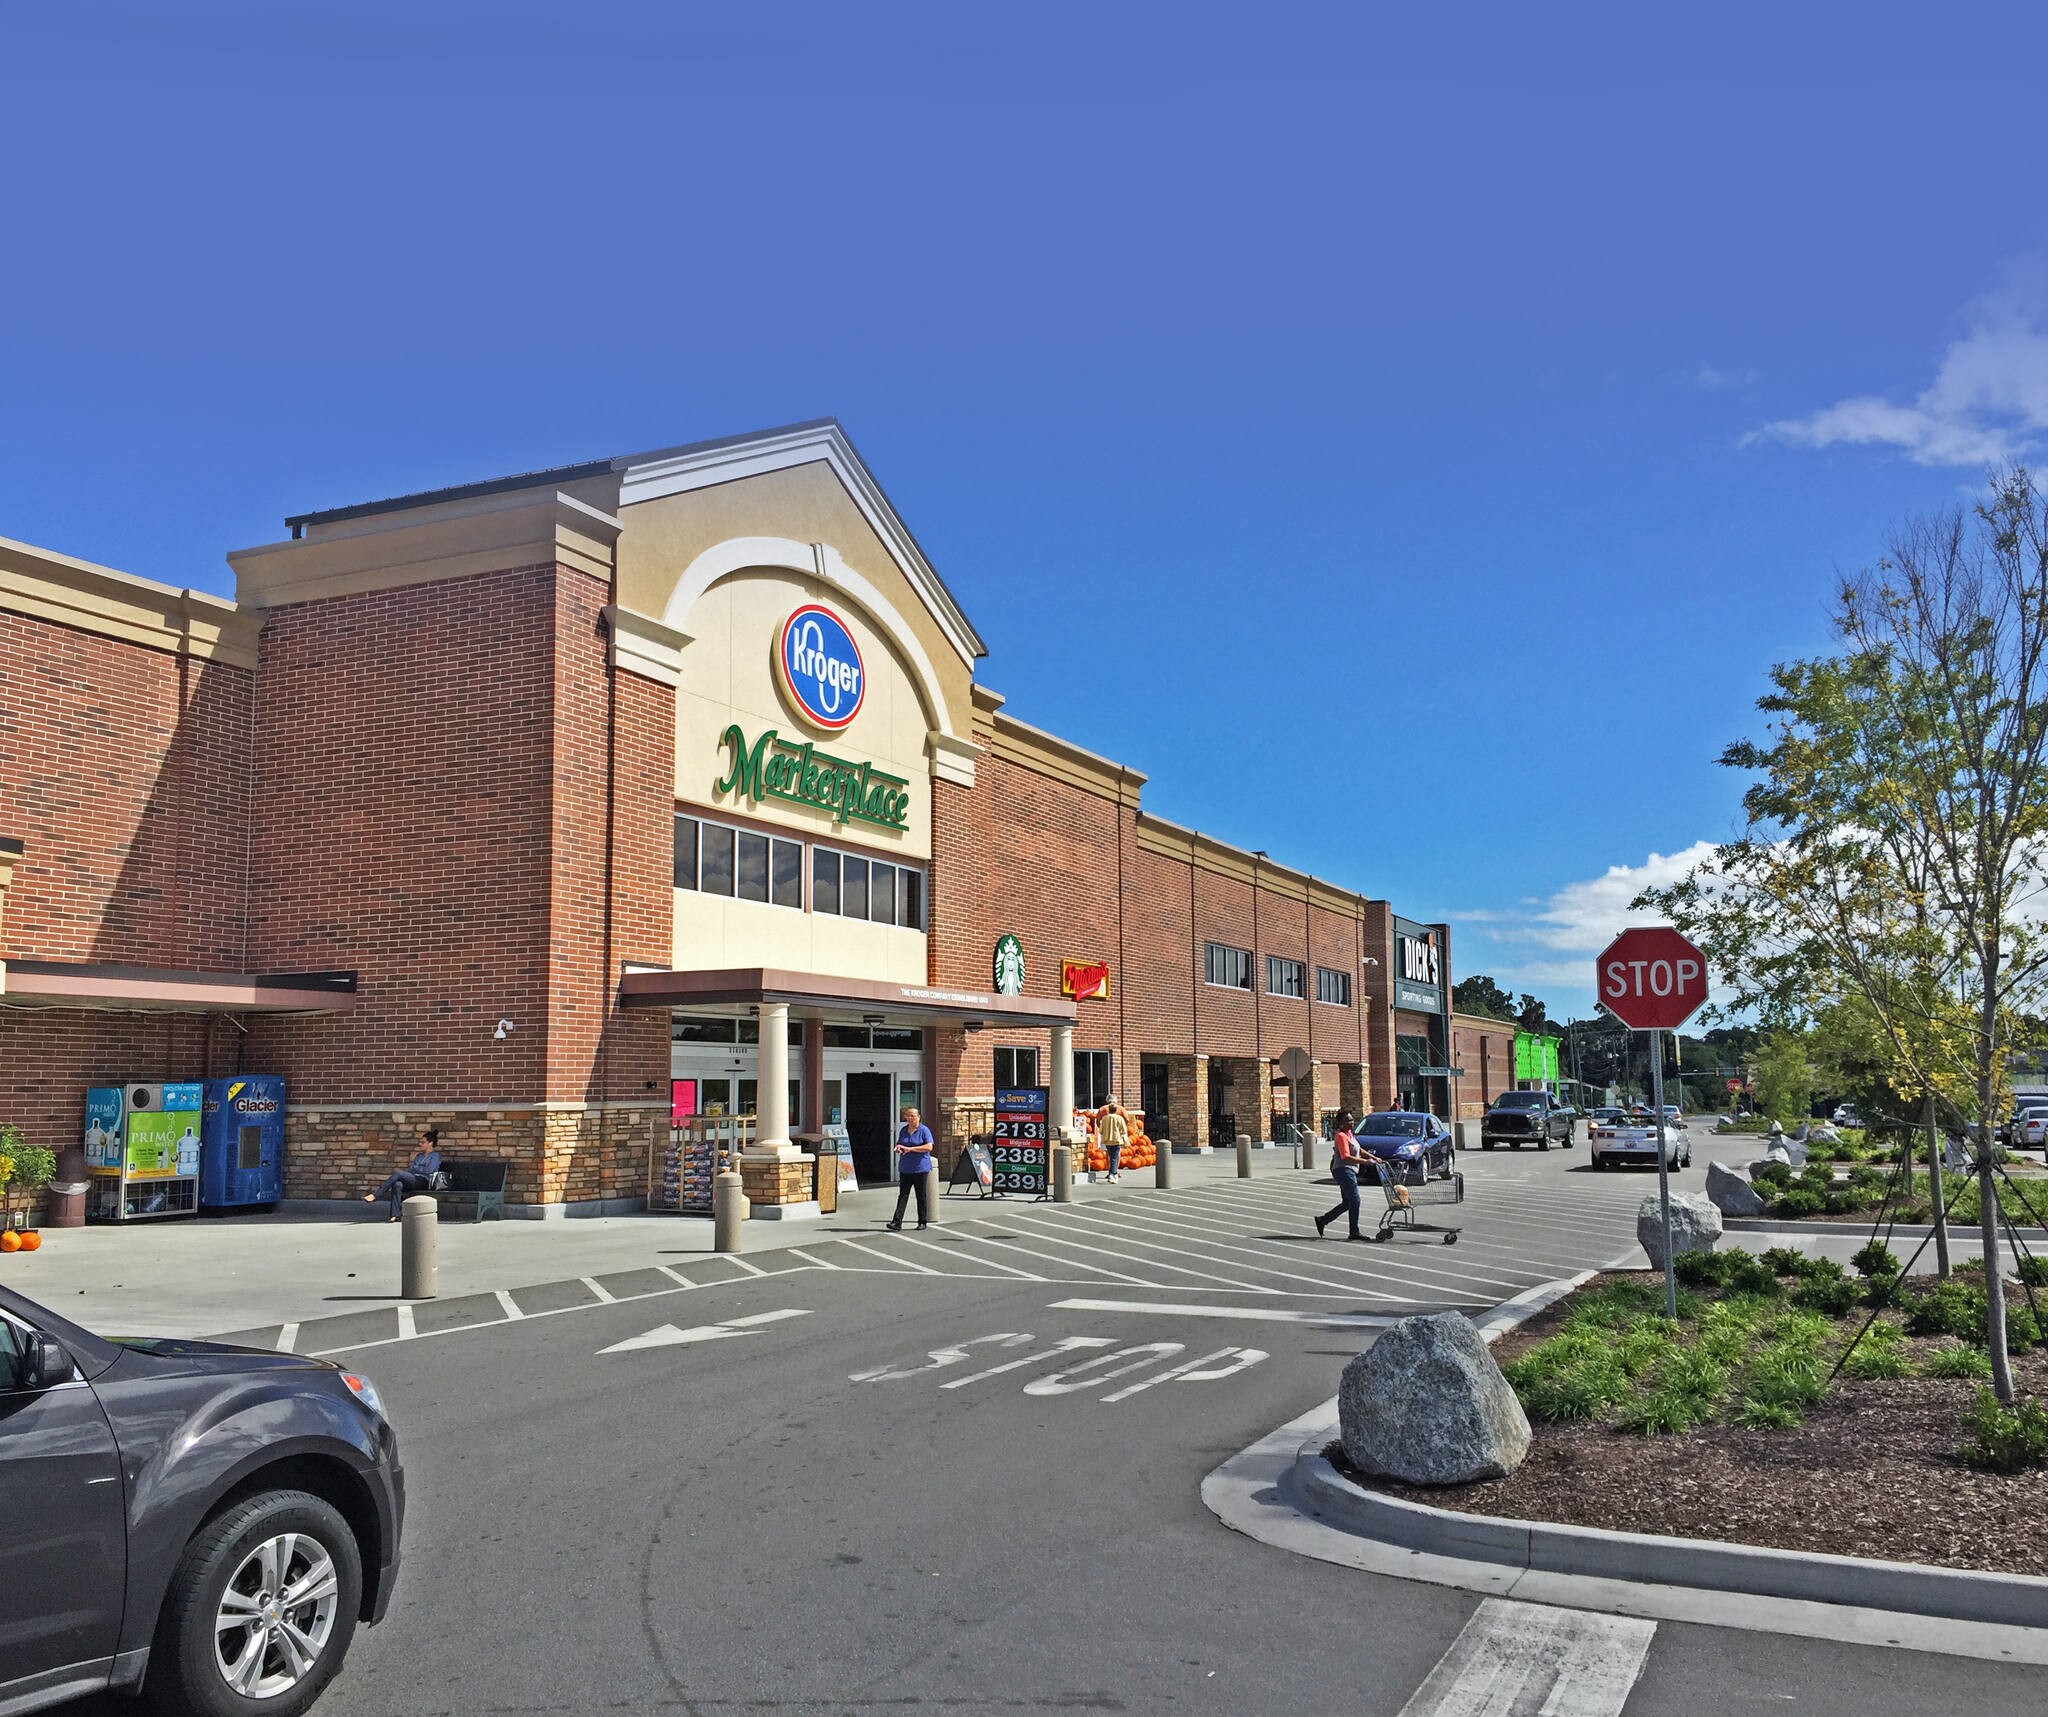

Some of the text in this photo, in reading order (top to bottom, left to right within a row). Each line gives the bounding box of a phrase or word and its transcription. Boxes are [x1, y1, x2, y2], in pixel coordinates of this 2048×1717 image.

[793, 620, 859, 714] Kroger
[718, 724, 910, 825] Marketplace
[1404, 933, 1438, 985] DICK'S
[1605, 960, 1699, 998] STOP
[900, 988, 911, 996] THE
[911, 989, 930, 998] KROGER
[1402, 991, 1421, 1003] SPORTING
[236, 1099, 278, 1112] Glacier
[1006, 1094, 1026, 1103] Save
[89, 1104, 117, 1113] PRIMO
[131, 1131, 176, 1143] PRIMO
[995, 1122, 1037, 1138] 213
[995, 1147, 1037, 1164] 238
[994, 1173, 1036, 1189] 239
[847, 1333, 1271, 1402] STOP
